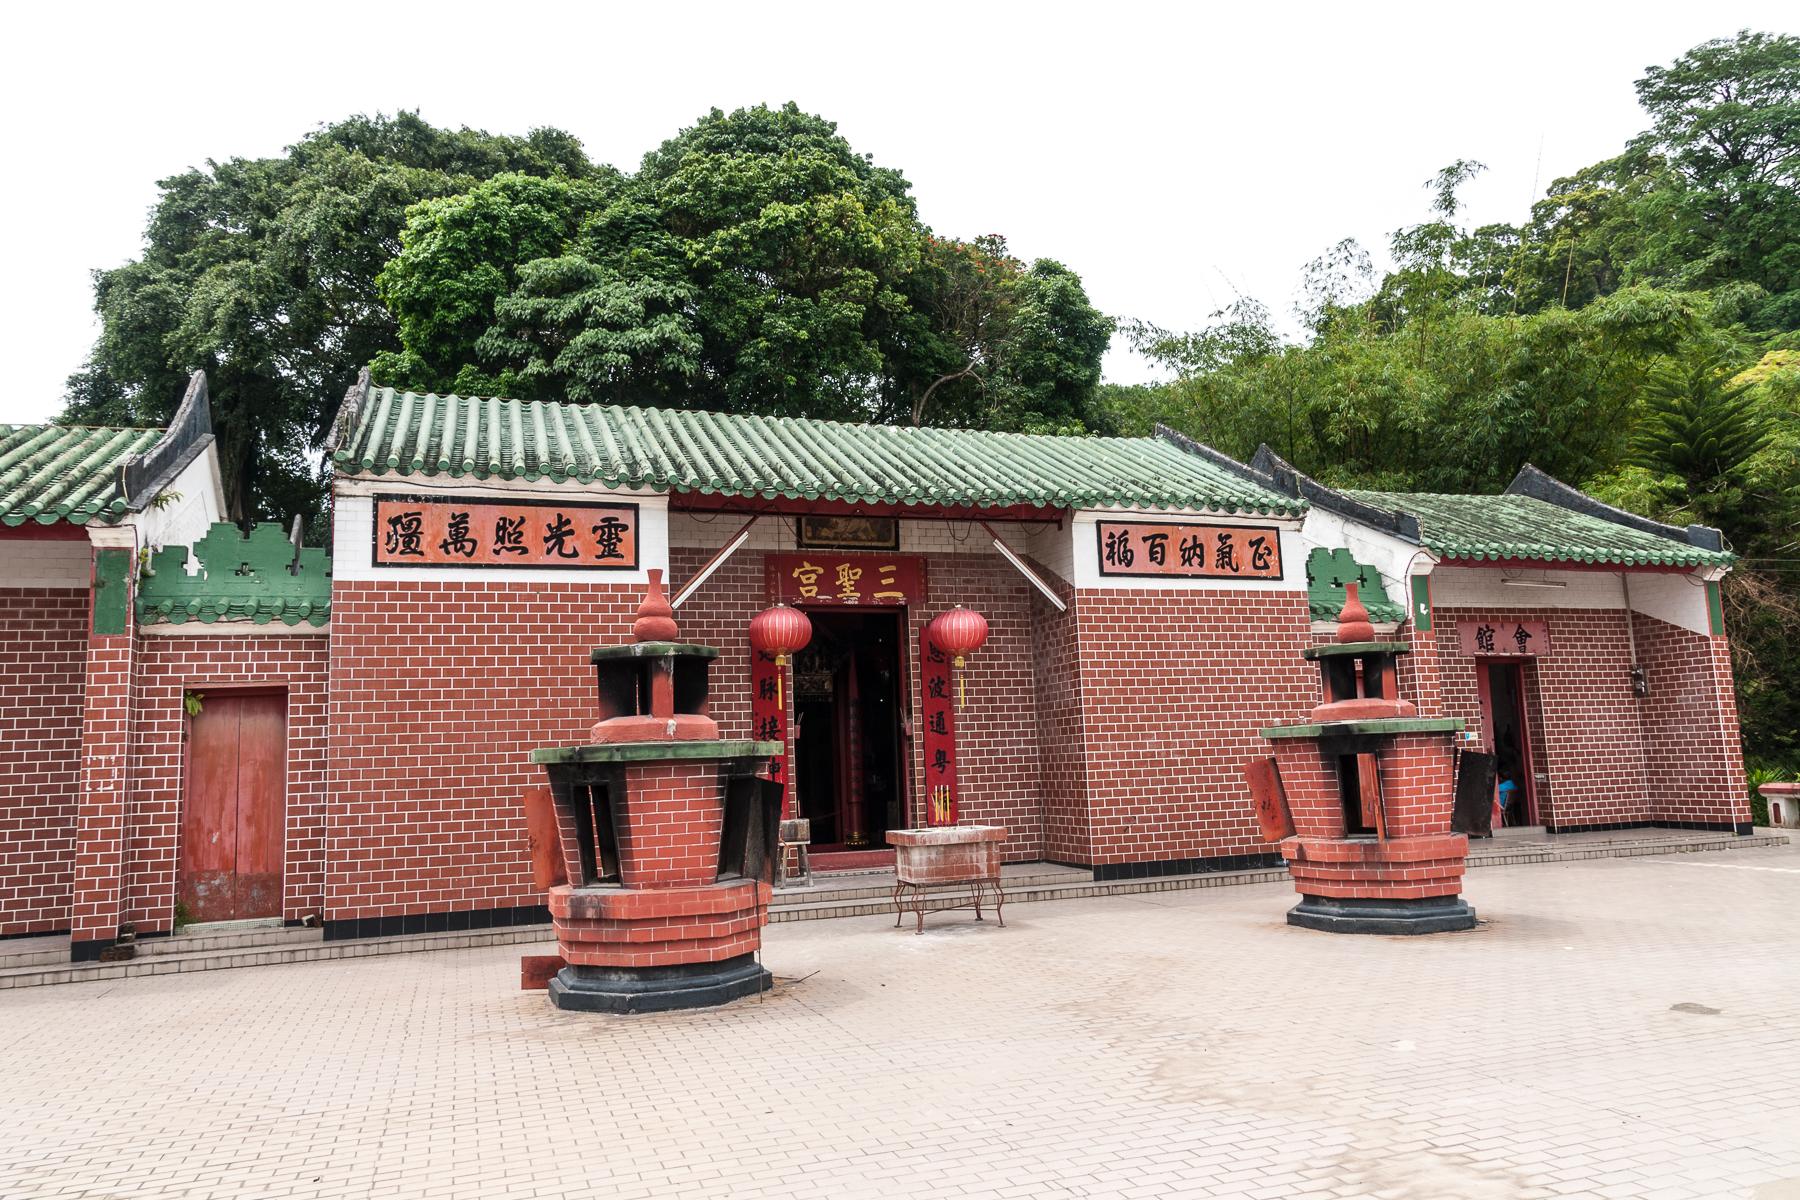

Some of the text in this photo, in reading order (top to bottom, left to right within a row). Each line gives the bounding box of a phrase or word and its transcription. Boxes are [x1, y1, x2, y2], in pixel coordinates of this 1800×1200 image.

[1104, 529, 1273, 573] 正氣納百福
[792, 560, 904, 600] 三聖宮
[1474, 623, 1533, 653] 會館
